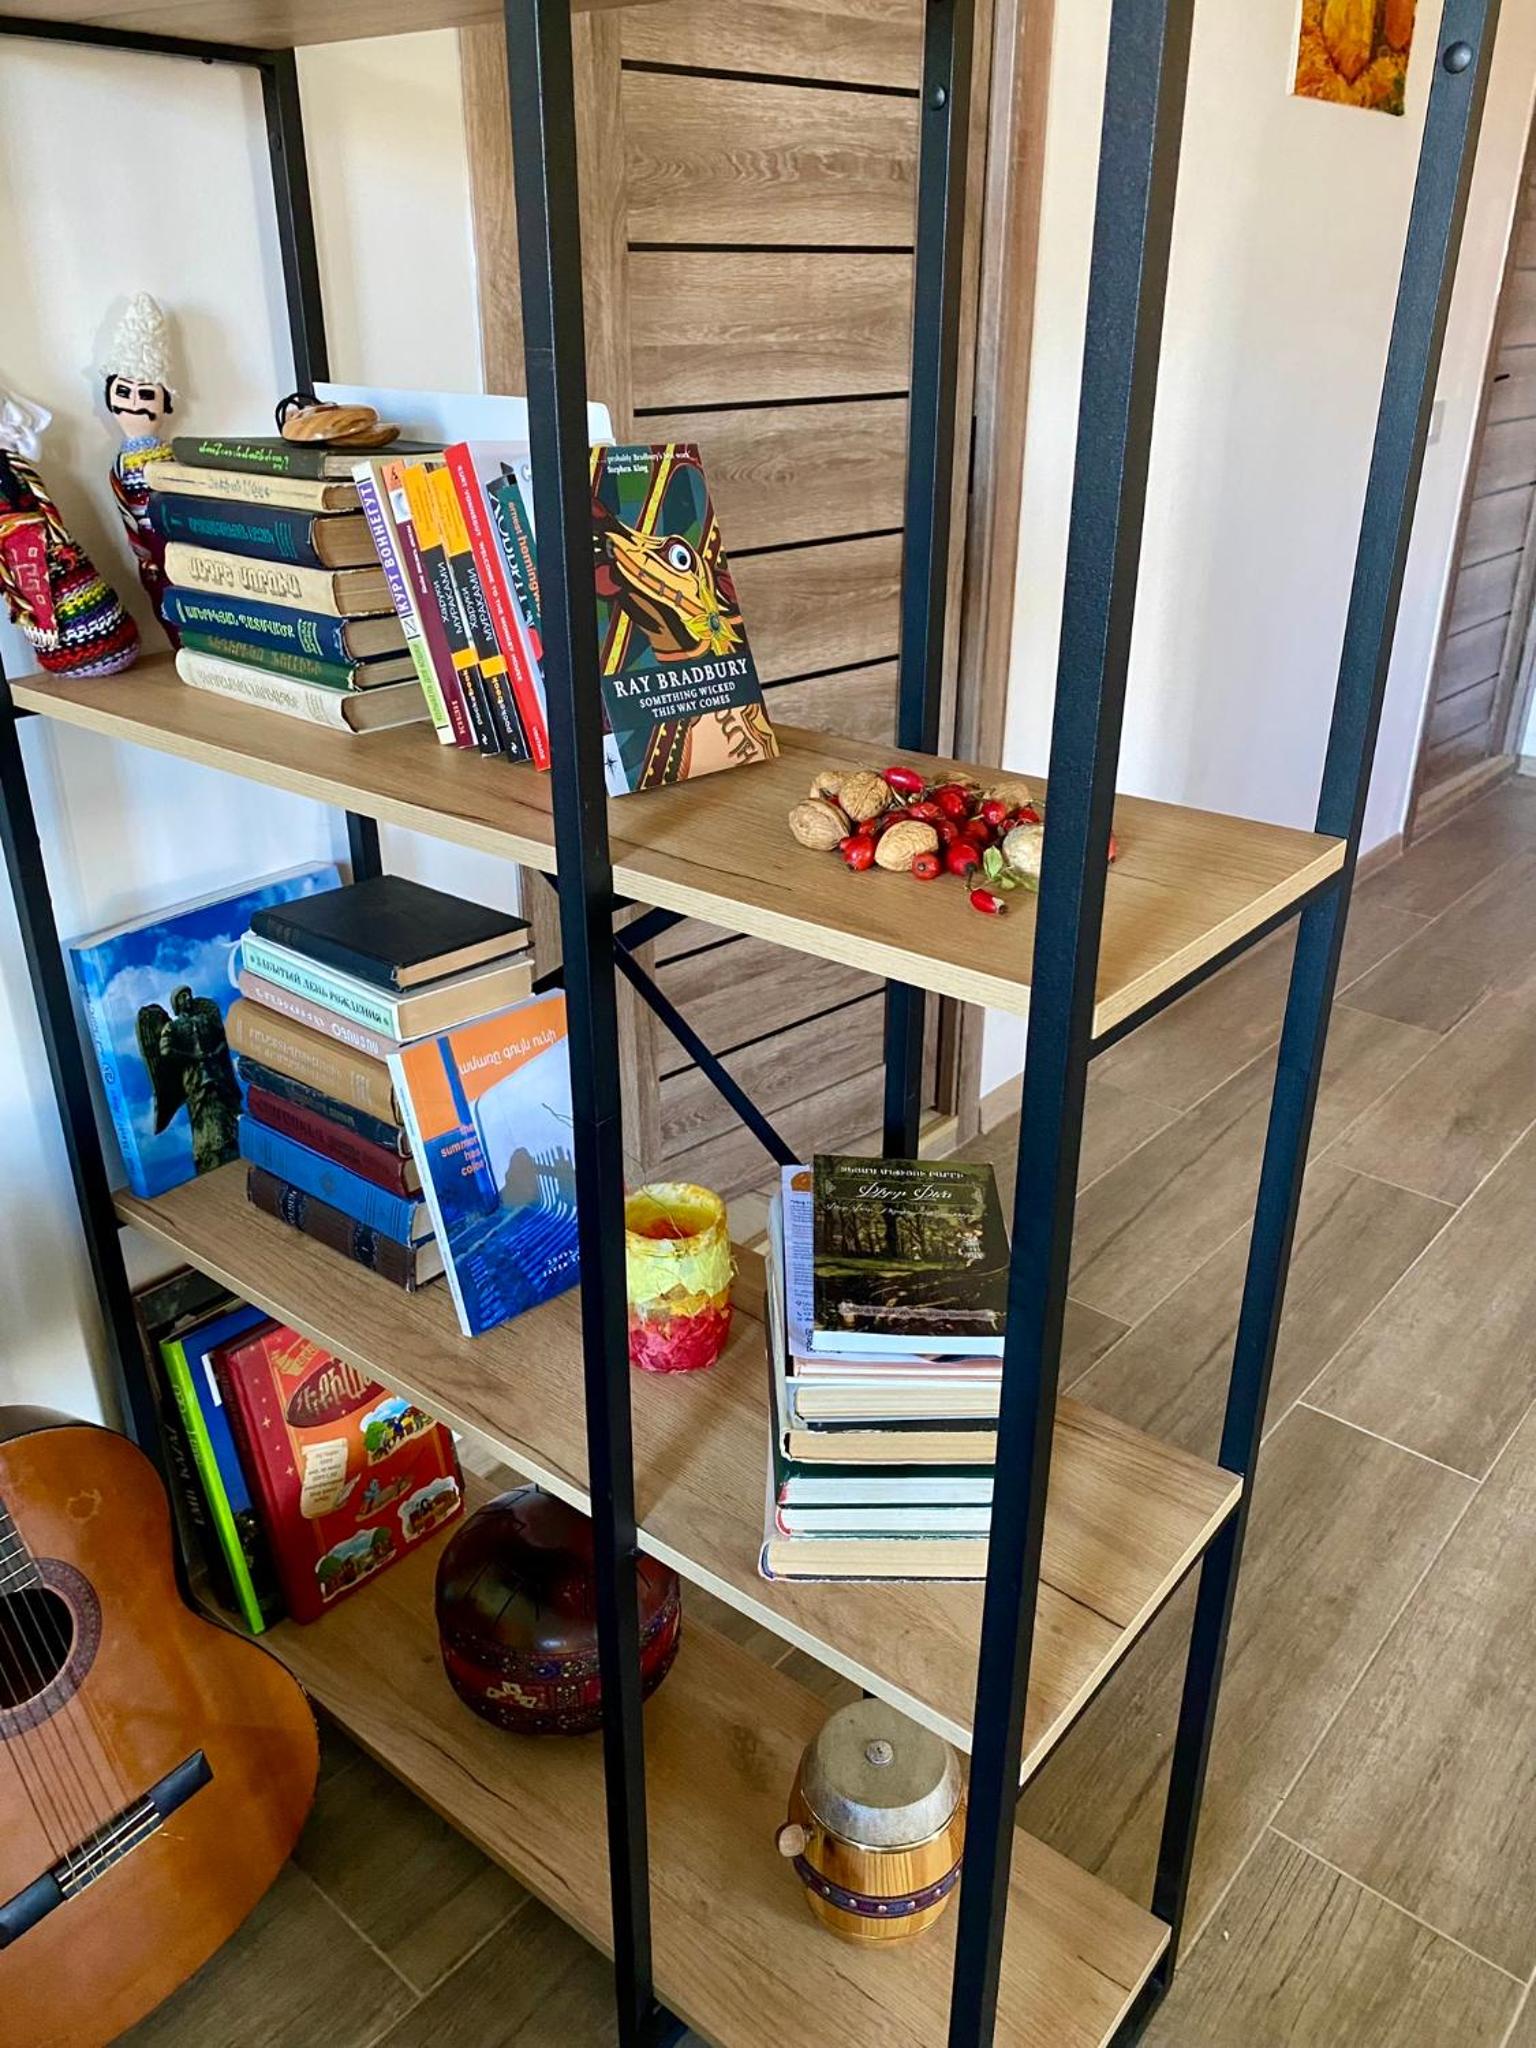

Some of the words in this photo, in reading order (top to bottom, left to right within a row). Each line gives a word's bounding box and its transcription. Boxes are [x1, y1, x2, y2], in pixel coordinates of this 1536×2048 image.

[633, 464, 648, 473] King
[360, 486, 395, 568] ВОННЕГУТ
[506, 501, 522, 534] ernest
[387, 572, 409, 611] КУРТ
[431, 579, 451, 623] Харуки
[435, 560, 464, 634] МУРАКАМИ
[459, 585, 479, 629] Харуки
[465, 566, 493, 641] МУРАКАМИ
[478, 541, 494, 583] WELCOME
[490, 585, 498, 597] TO
[494, 598, 503, 615] THE
[499, 615, 513, 652] MONKEY
[510, 653, 523, 682] HOUSE
[612, 674, 652, 698] RAY
[656, 657, 749, 689] BRADBURY
[638, 686, 697, 708] SOMETHING
[698, 680, 736, 697] WICKED
[651, 704, 676, 718] THIS
[676, 700, 697, 713] WAY
[698, 693, 730, 709] COMES
